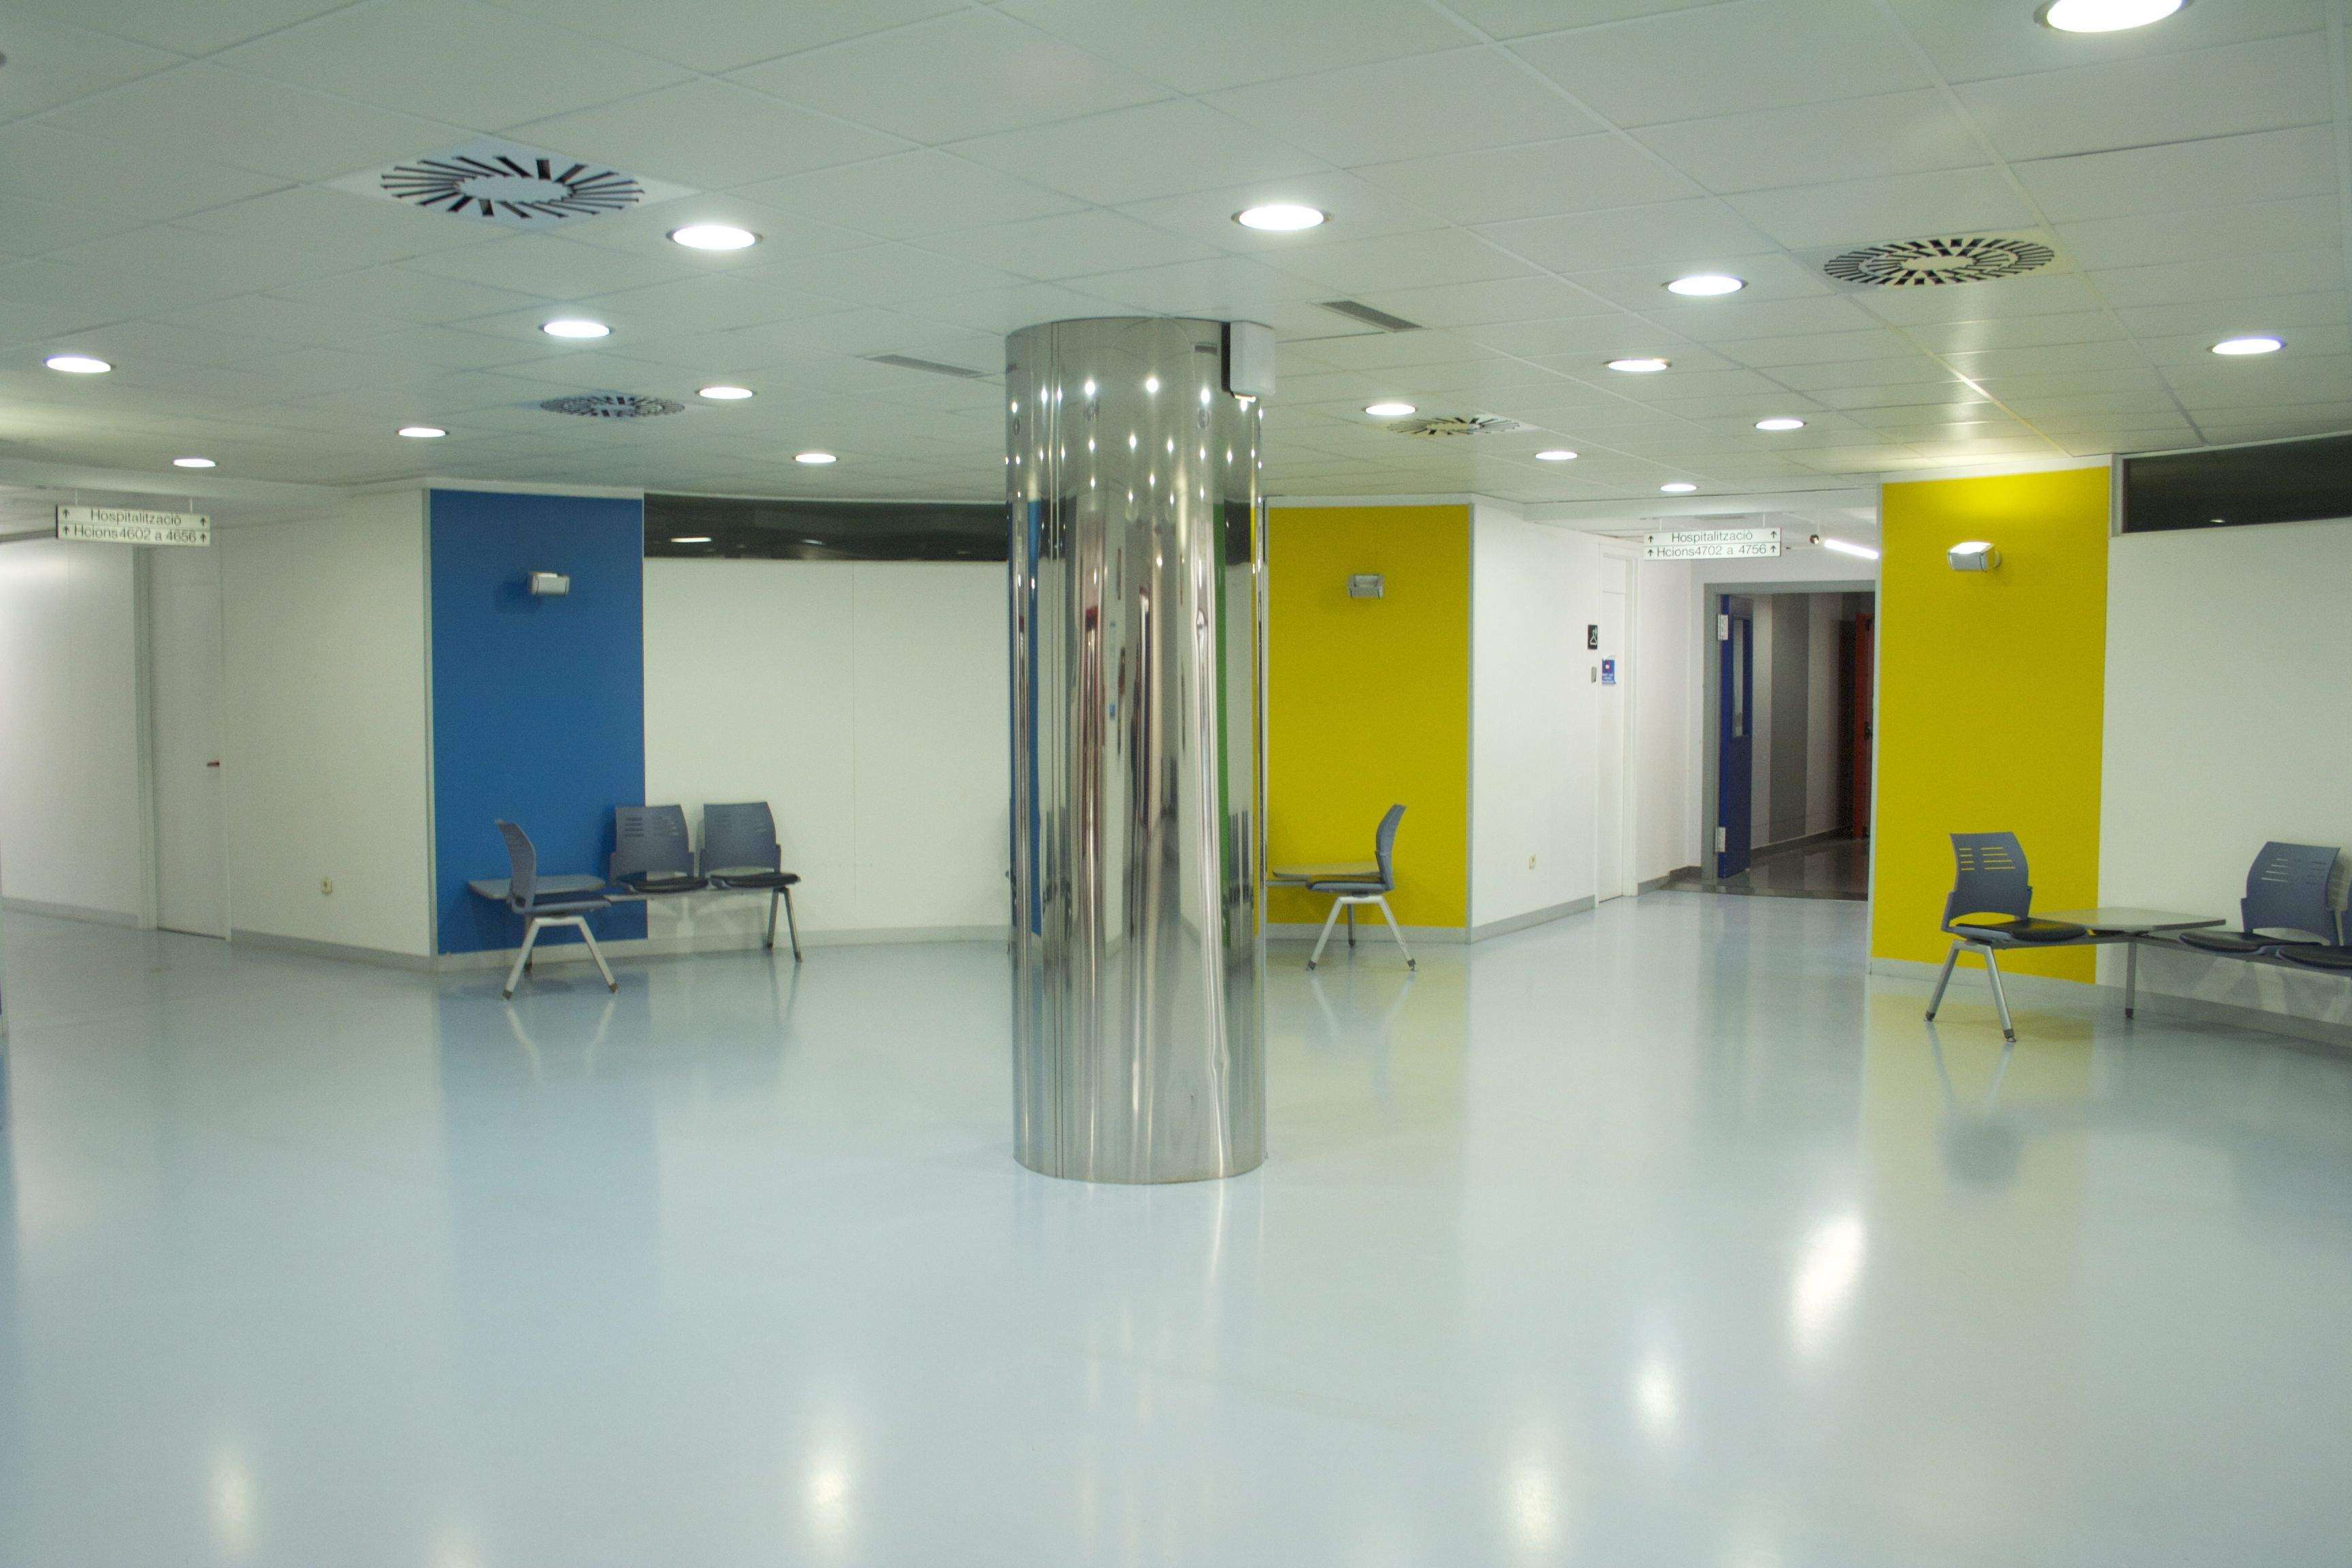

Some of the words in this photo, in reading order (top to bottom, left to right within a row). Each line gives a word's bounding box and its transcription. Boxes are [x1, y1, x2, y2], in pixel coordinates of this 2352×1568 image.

[155, 533, 162, 541] a
[166, 529, 197, 543] 4656
[1727, 547, 1733, 555] a
[1739, 544, 1767, 555] 4756
